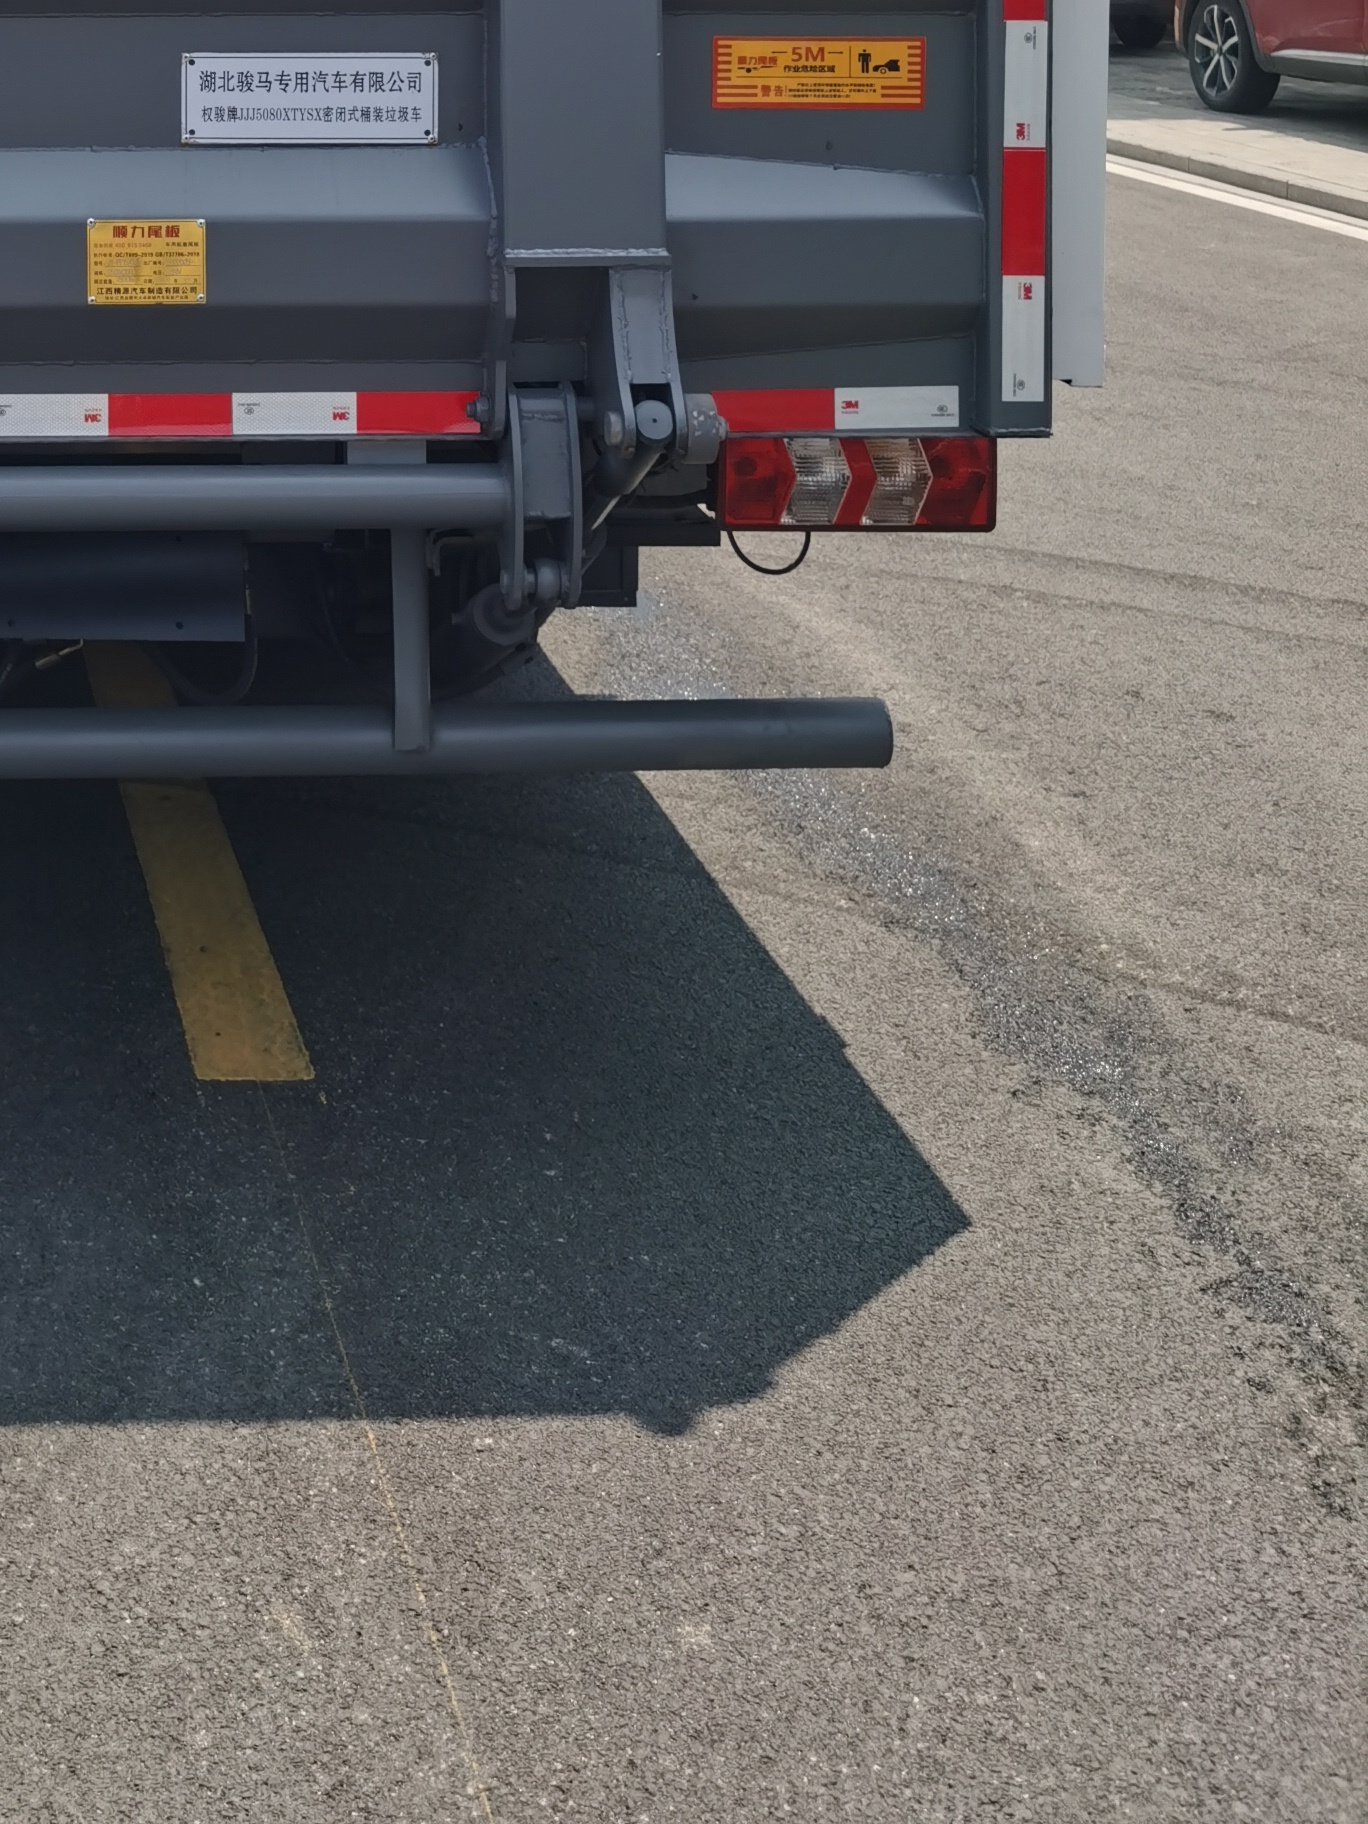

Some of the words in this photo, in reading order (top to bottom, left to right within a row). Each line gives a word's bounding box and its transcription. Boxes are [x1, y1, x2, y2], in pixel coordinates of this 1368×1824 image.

[791, 46, 825, 62] 5M
[198, 70, 423, 93] 湖北骏马专用汽车有限公司
[1016, 123, 1026, 141] 3M
[112, 225, 180, 238] 顺力尾板
[1023, 282, 1032, 301] 3M
[841, 400, 859, 410] 3M
[84, 413, 102, 422] 3M
[332, 411, 350, 420] 3M
